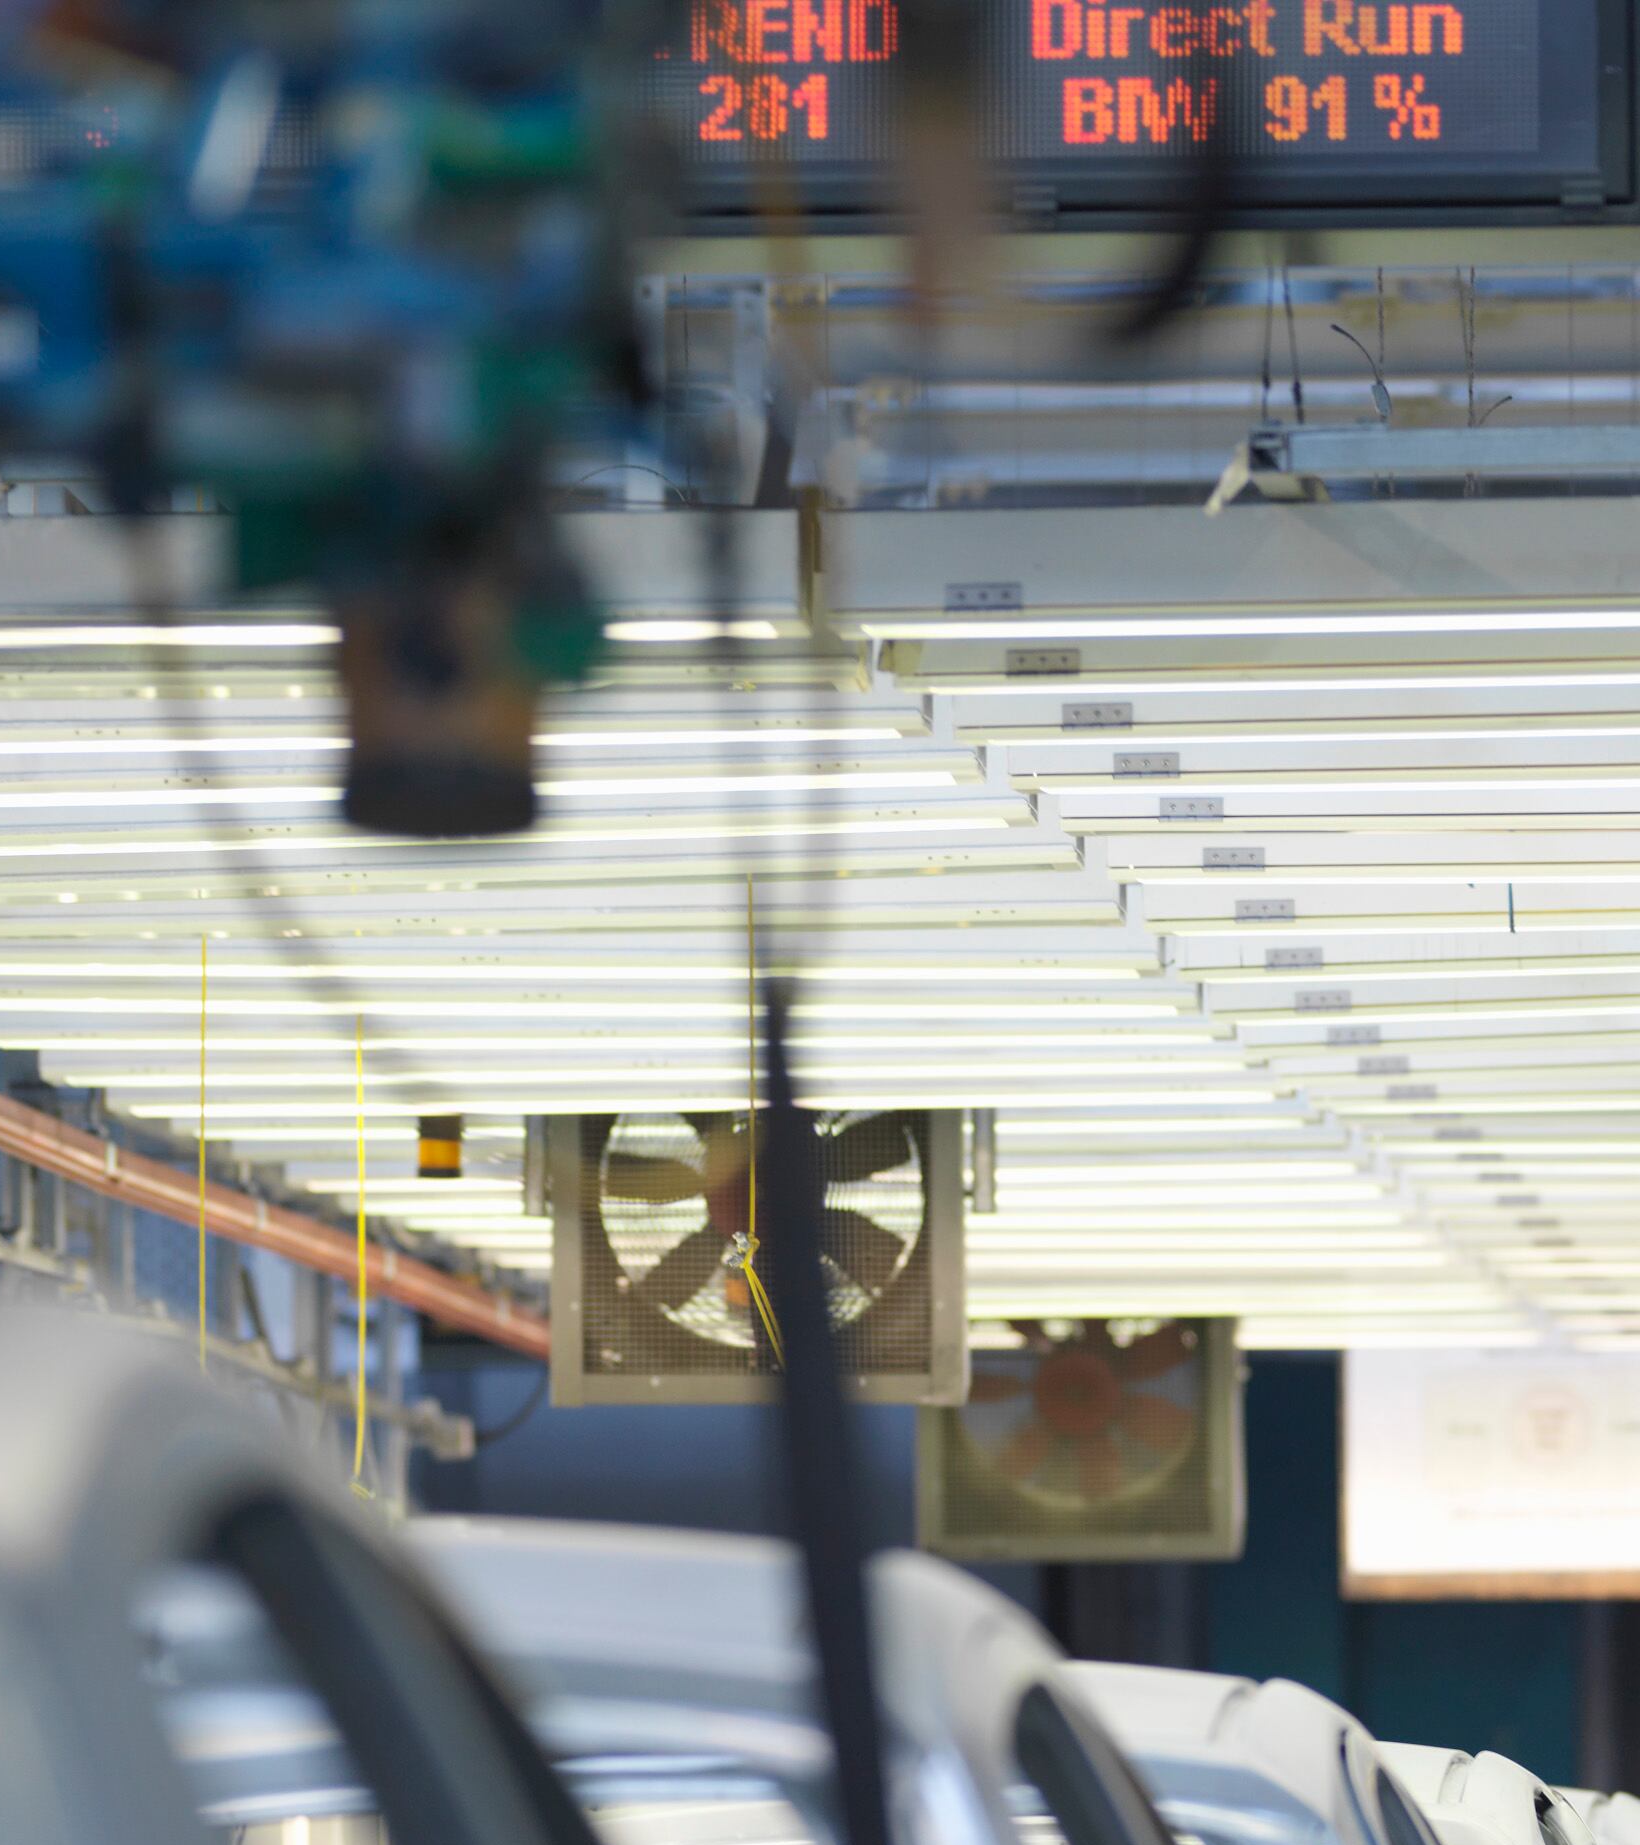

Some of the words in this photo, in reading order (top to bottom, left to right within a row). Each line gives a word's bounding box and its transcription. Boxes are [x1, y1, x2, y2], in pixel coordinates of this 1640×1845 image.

[653, 0, 900, 63] REND
[1031, 0, 1275, 59] Direct
[1303, 0, 1463, 56] Run
[1265, 75, 1346, 141] 91
[1374, 74, 1441, 140] %
